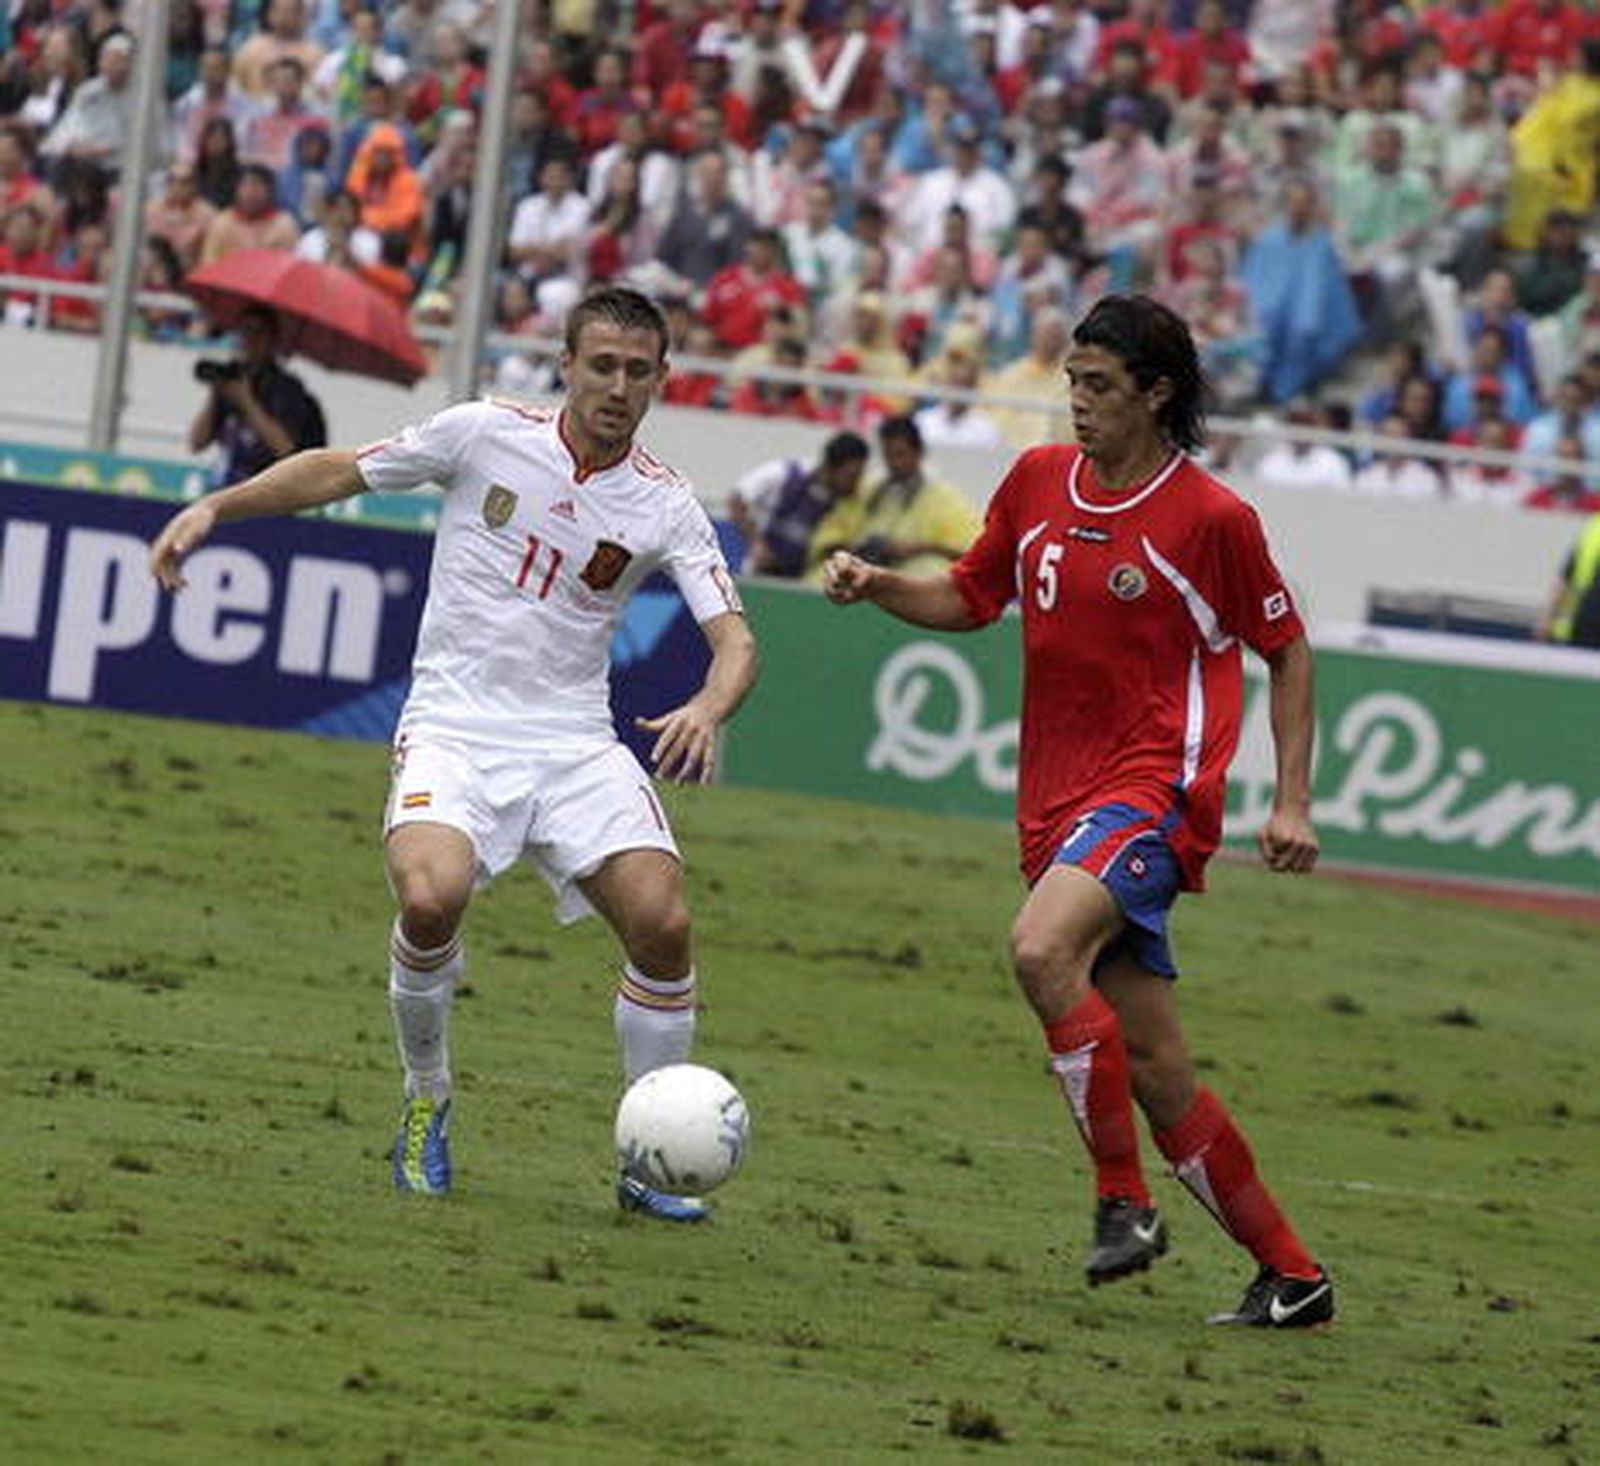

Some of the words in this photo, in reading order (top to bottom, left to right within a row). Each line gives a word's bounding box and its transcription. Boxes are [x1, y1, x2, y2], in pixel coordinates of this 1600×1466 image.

[516, 533, 563, 600] 11
[1036, 542, 1064, 611] 5
[866, 639, 1021, 793] Do
[1333, 690, 1600, 860] Pin
